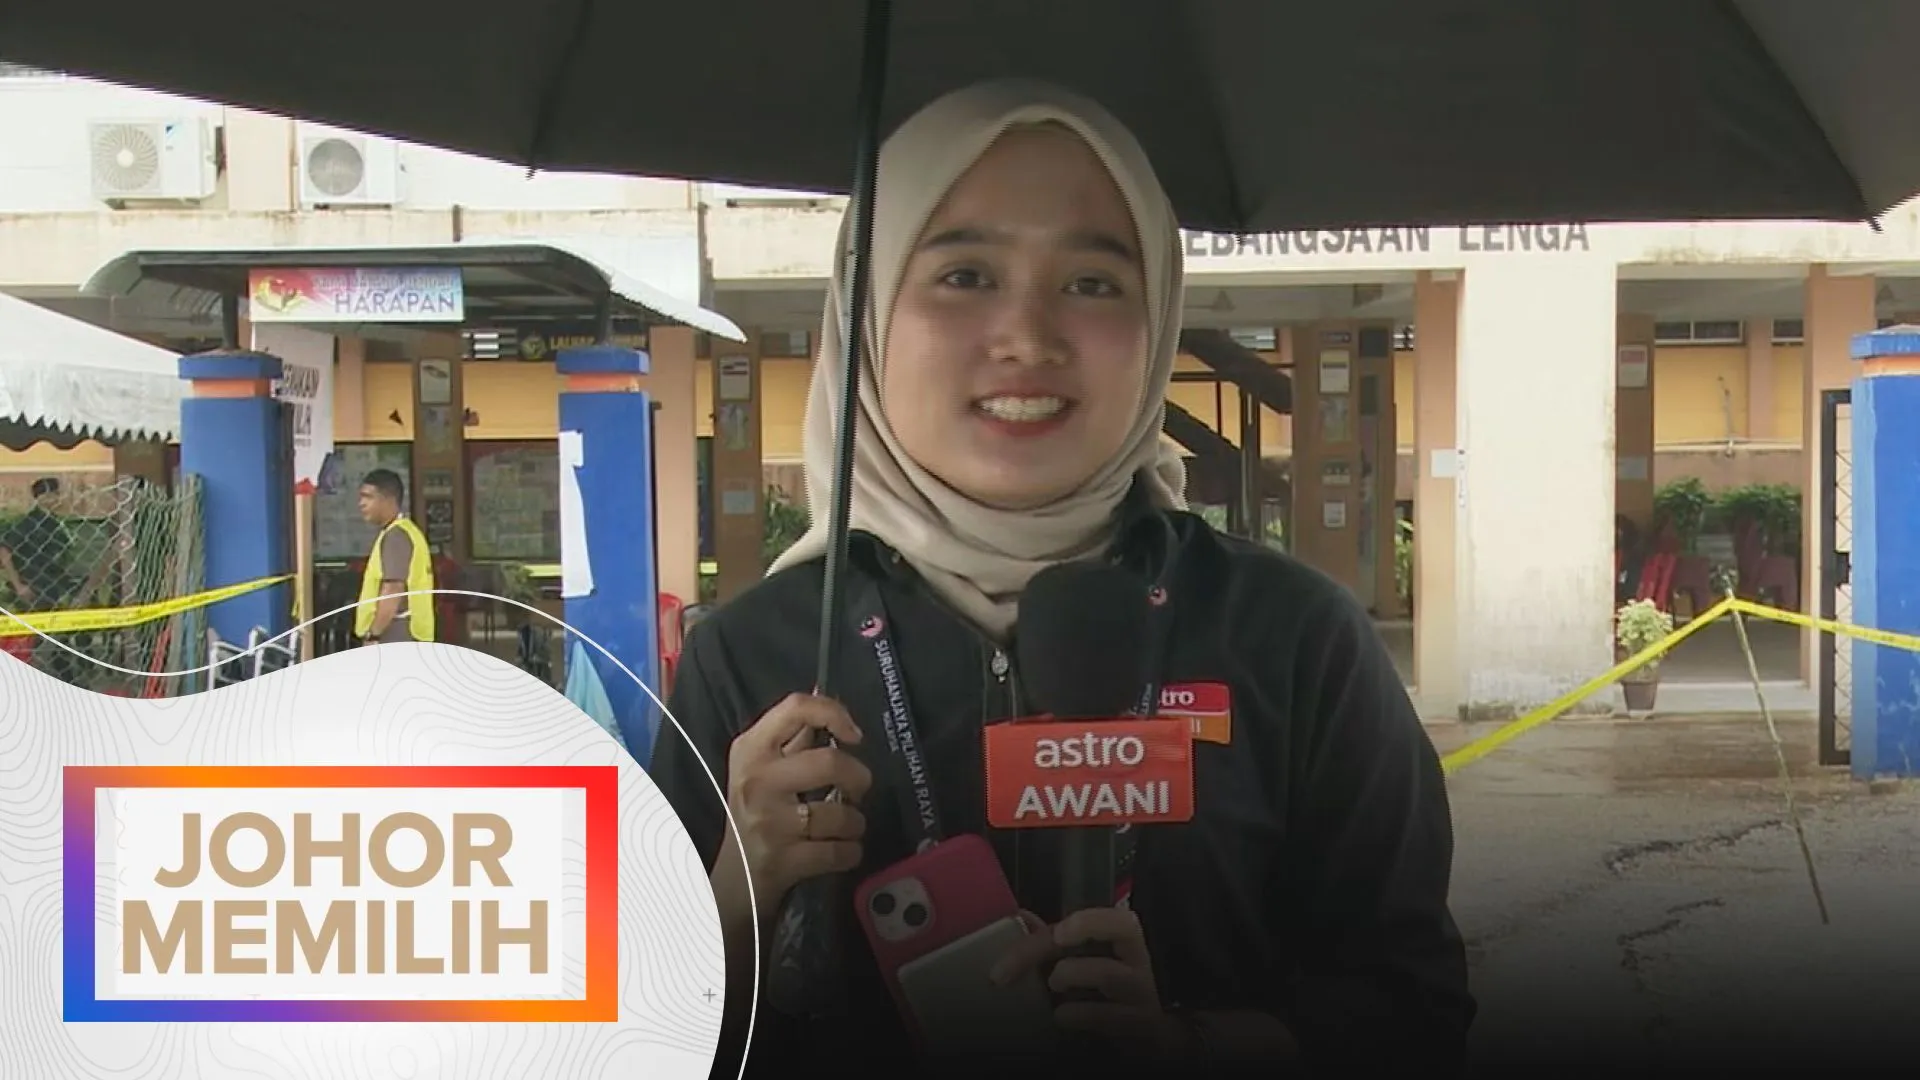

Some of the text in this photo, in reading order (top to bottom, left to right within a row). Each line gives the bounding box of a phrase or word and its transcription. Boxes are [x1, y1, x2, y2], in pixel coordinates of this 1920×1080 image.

[1185, 222, 1590, 256] EBANGSAAN LENGA
[334, 291, 455, 313] HARAPAN
[1158, 688, 1195, 707] tro
[1034, 731, 1145, 768] astro
[899, 731, 926, 785] PILIHAN
[915, 786, 937, 830] RAYA
[1013, 780, 1170, 819] AWANI
